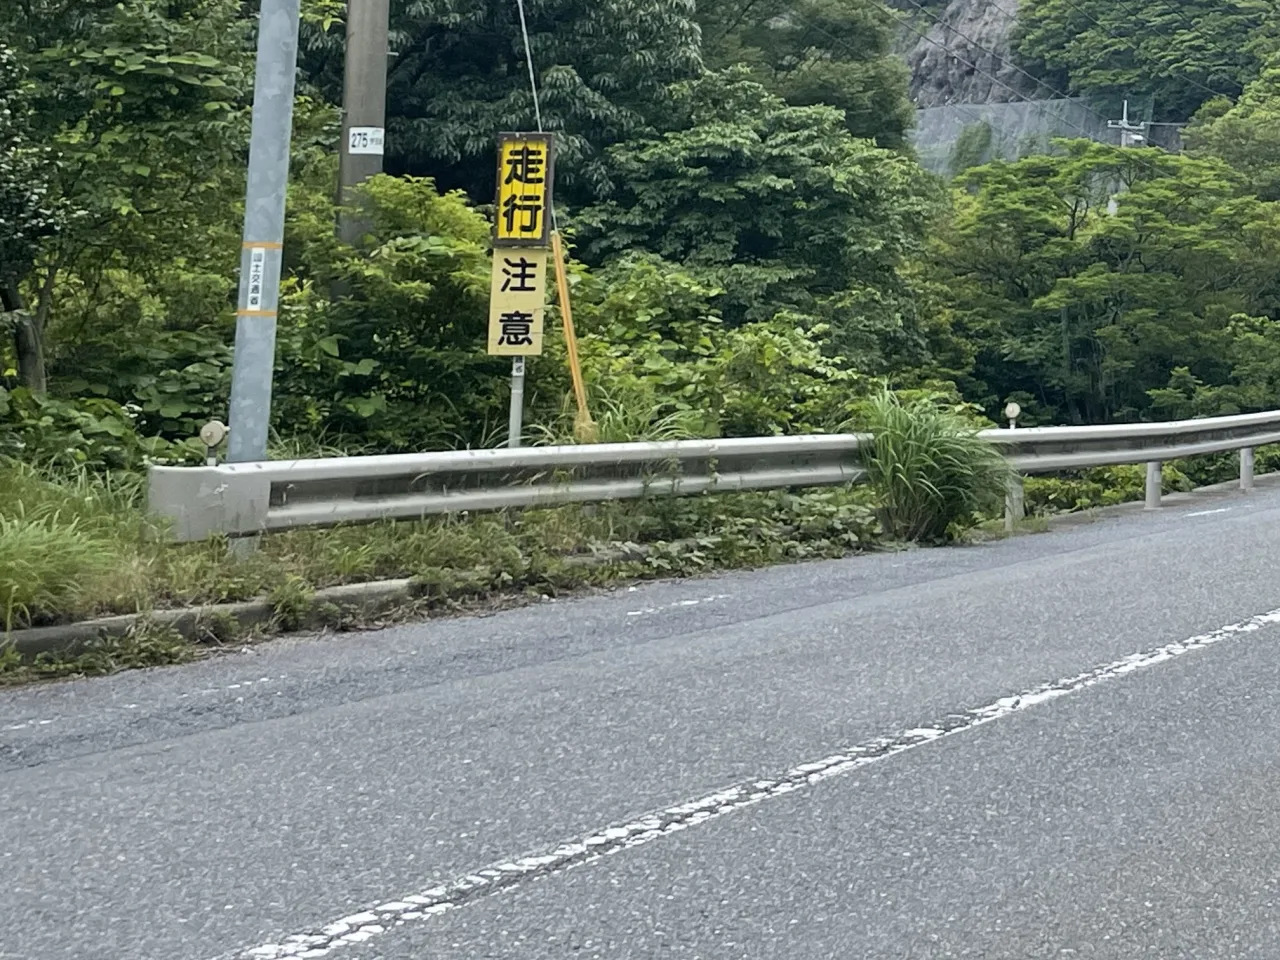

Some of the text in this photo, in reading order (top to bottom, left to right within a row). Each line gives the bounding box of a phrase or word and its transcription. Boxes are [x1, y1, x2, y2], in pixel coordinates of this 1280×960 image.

[351, 132, 368, 148] 275
[502, 146, 544, 232] 走行
[498, 257, 538, 346] 注意
